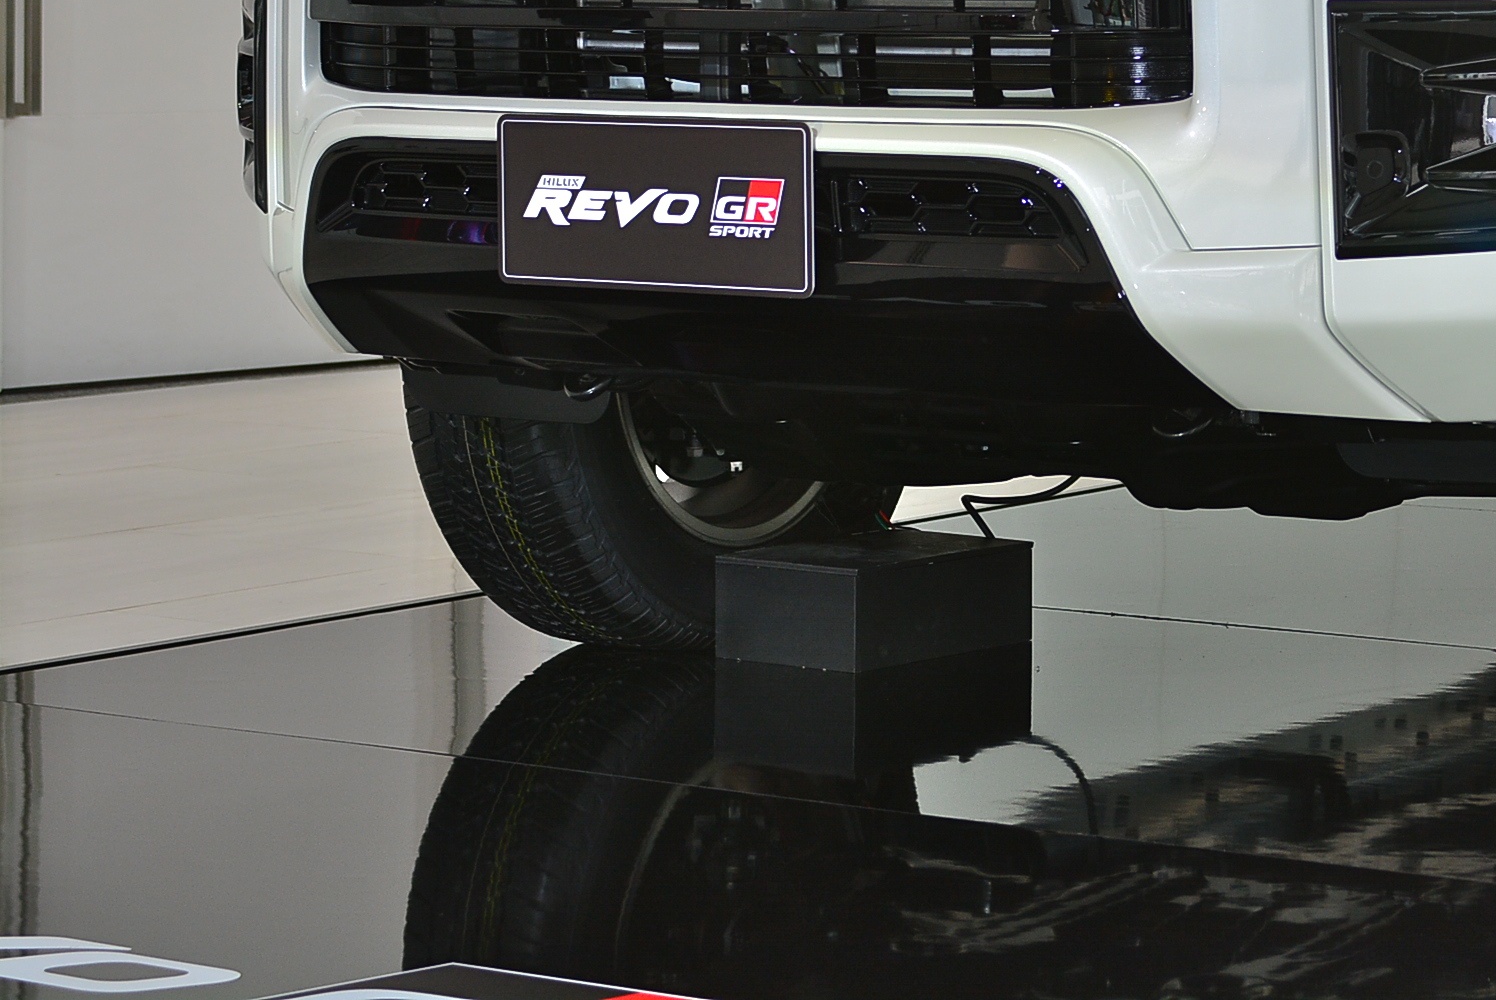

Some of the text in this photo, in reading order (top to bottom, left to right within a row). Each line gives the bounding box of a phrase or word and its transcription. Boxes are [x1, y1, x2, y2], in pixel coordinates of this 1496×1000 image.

[543, 177, 579, 187] HILUX
[523, 188, 777, 228] REVO GR
[709, 225, 774, 238] SPORT
